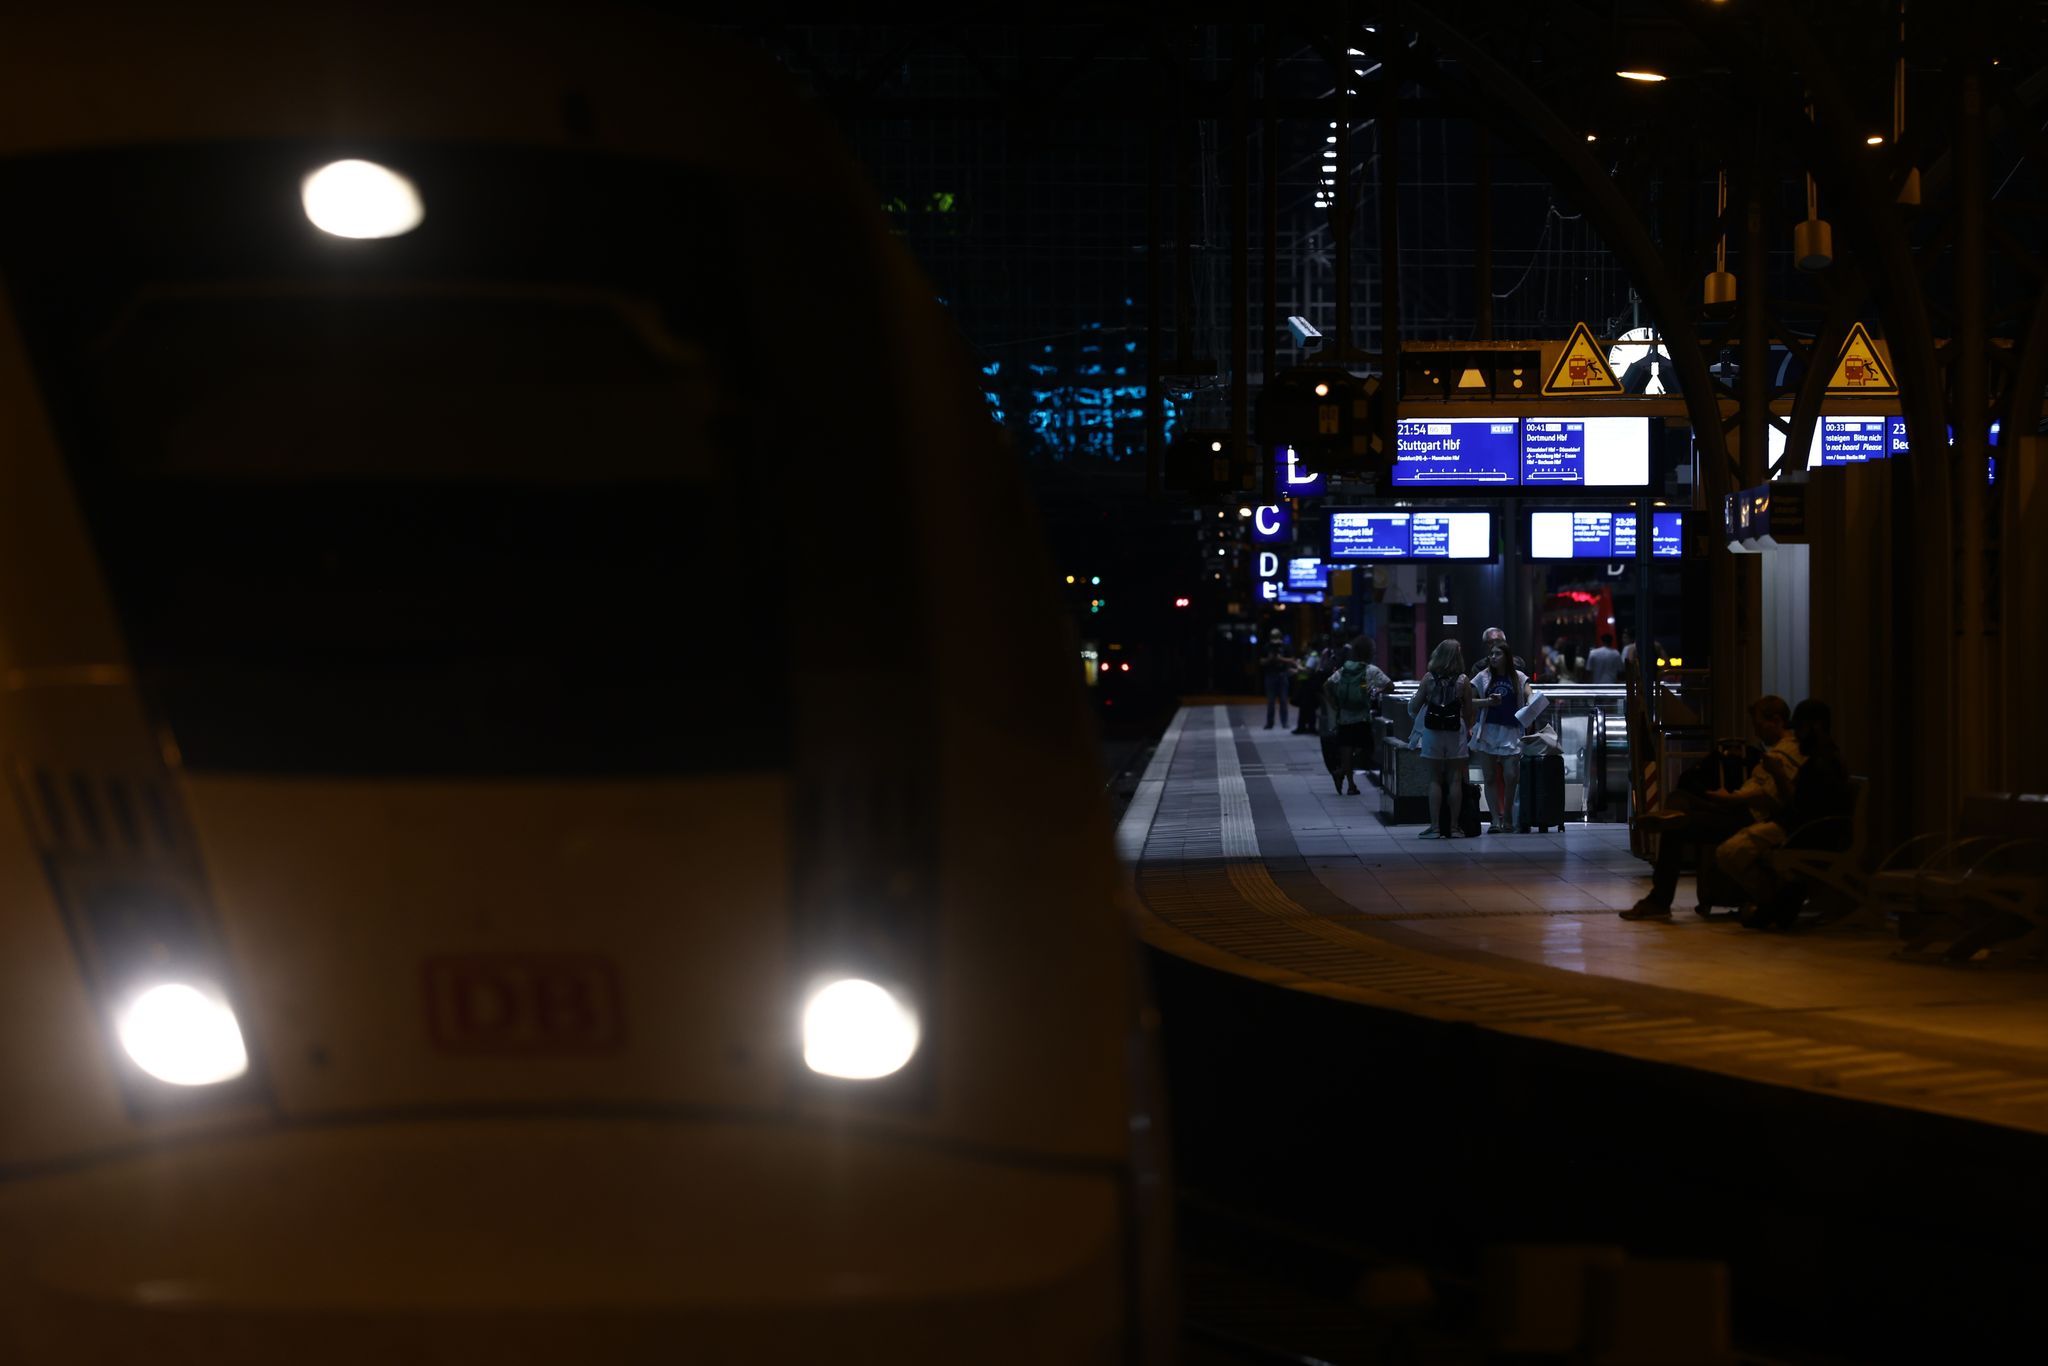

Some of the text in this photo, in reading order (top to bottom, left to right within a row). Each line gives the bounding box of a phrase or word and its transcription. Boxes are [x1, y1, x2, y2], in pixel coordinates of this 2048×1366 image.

[1397, 424, 1426, 435] 21:54
[1526, 423, 1545, 431] 00:41
[1526, 433, 1568, 441] Dortmund Hbf
[1397, 439, 1460, 453] Stuttgart Hbf
[1831, 443, 1842, 451] not
[1863, 443, 1882, 451] Please
[1255, 504, 1280, 535] C
[1259, 552, 1279, 577] D
[452, 972, 602, 1036] DB
